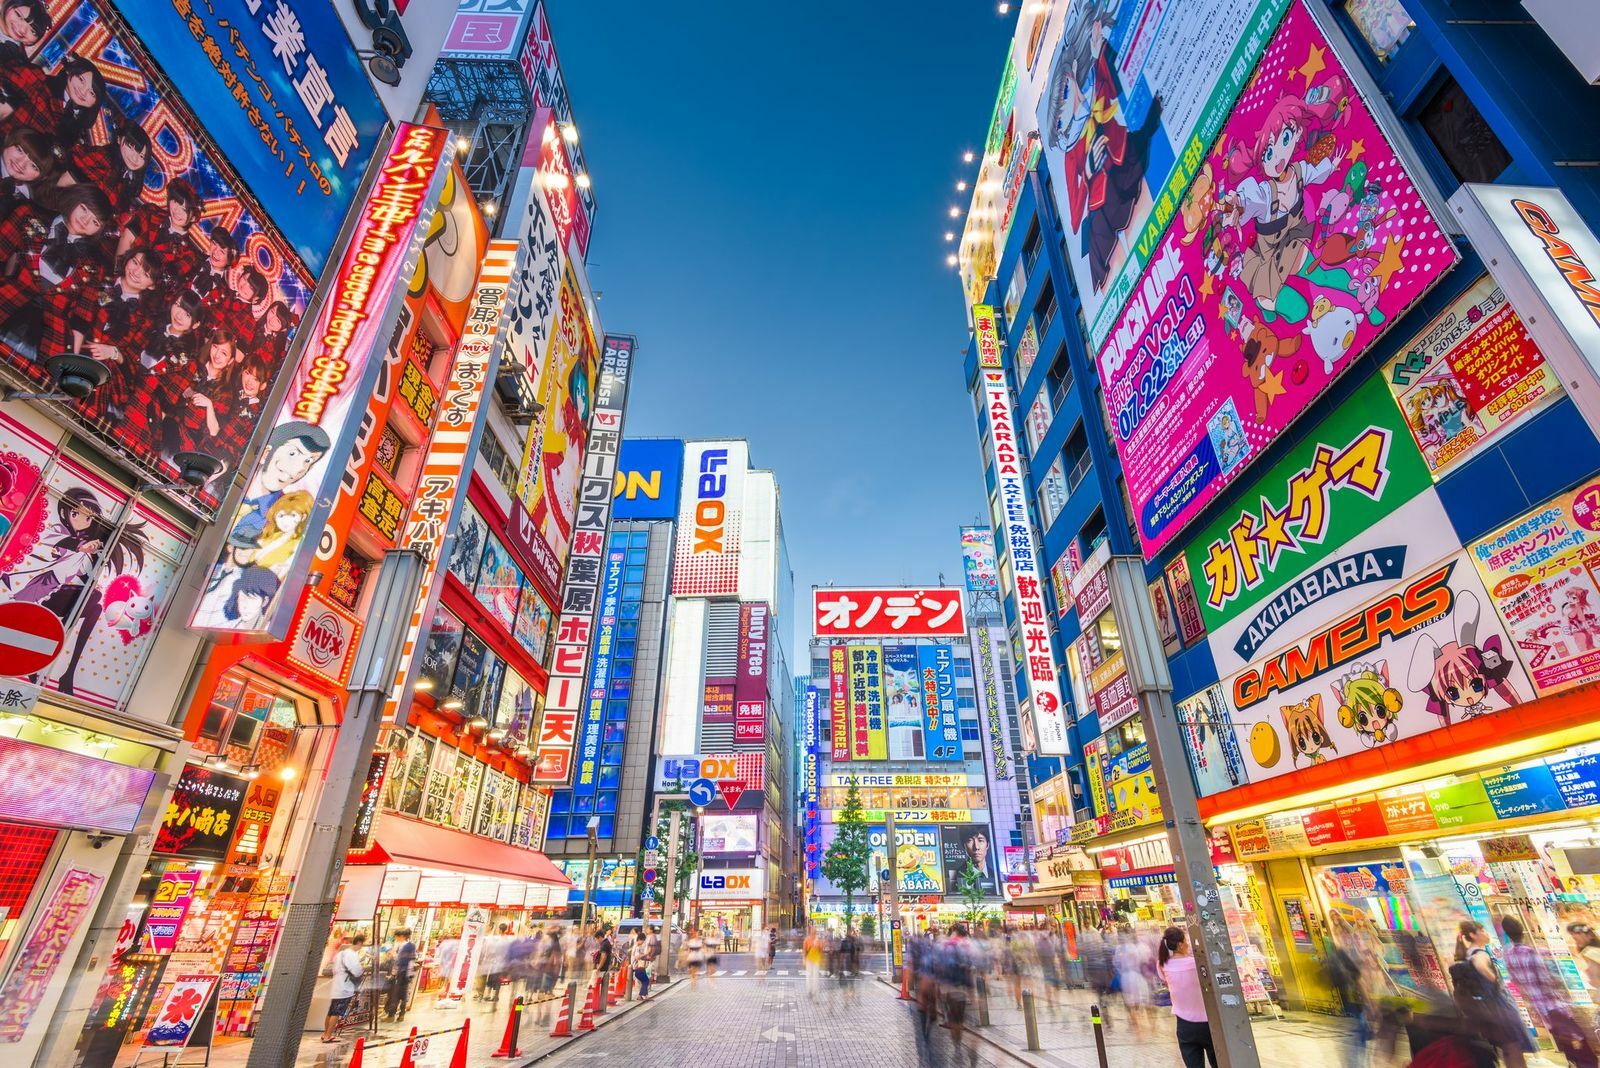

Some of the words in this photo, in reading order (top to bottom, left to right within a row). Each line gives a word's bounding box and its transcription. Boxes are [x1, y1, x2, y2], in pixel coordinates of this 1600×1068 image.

[243, 0, 359, 168] 業宣言
[1216, 82, 1232, 104] 2015
[471, 287, 505, 335] 買取り
[1434, 288, 1506, 357] 2015年5月号
[1166, 311, 1206, 378] SALE!!
[1453, 313, 1521, 374] 魔法少女リリカル
[598, 339, 619, 406] PARADISE
[615, 340, 631, 385] HOBBY
[1476, 343, 1521, 381] オリジナル
[1113, 382, 1134, 416] DVD
[1117, 355, 1167, 441] 07.22
[1163, 331, 1180, 358] ON
[988, 391, 1019, 475] TAKARADA
[1421, 400, 1466, 440] SAMPLE
[818, 591, 959, 630] オノデン
[1249, 552, 1383, 649] AKIHABARA
[740, 606, 750, 637] Flagship
[748, 606, 767, 641] Duty
[1233, 559, 1458, 712] GAMERS
[740, 638, 749, 660] Store
[748, 642, 767, 676] Free
[590, 689, 606, 698] 4F
[739, 704, 762, 715] 免税
[807, 691, 817, 746] Panasonic
[1053, 721, 1063, 742] Japan
[933, 746, 956, 758] 4F
[248, 784, 277, 808] 入口
[723, 785, 742, 793] 止まれ
[808, 753, 817, 803] ONODEN
[837, 776, 860, 785] TAX
[863, 776, 893, 785] FREE
[895, 811, 929, 821] エアコン
[155, 880, 193, 903] 2F
[871, 881, 940, 890] AABARA
